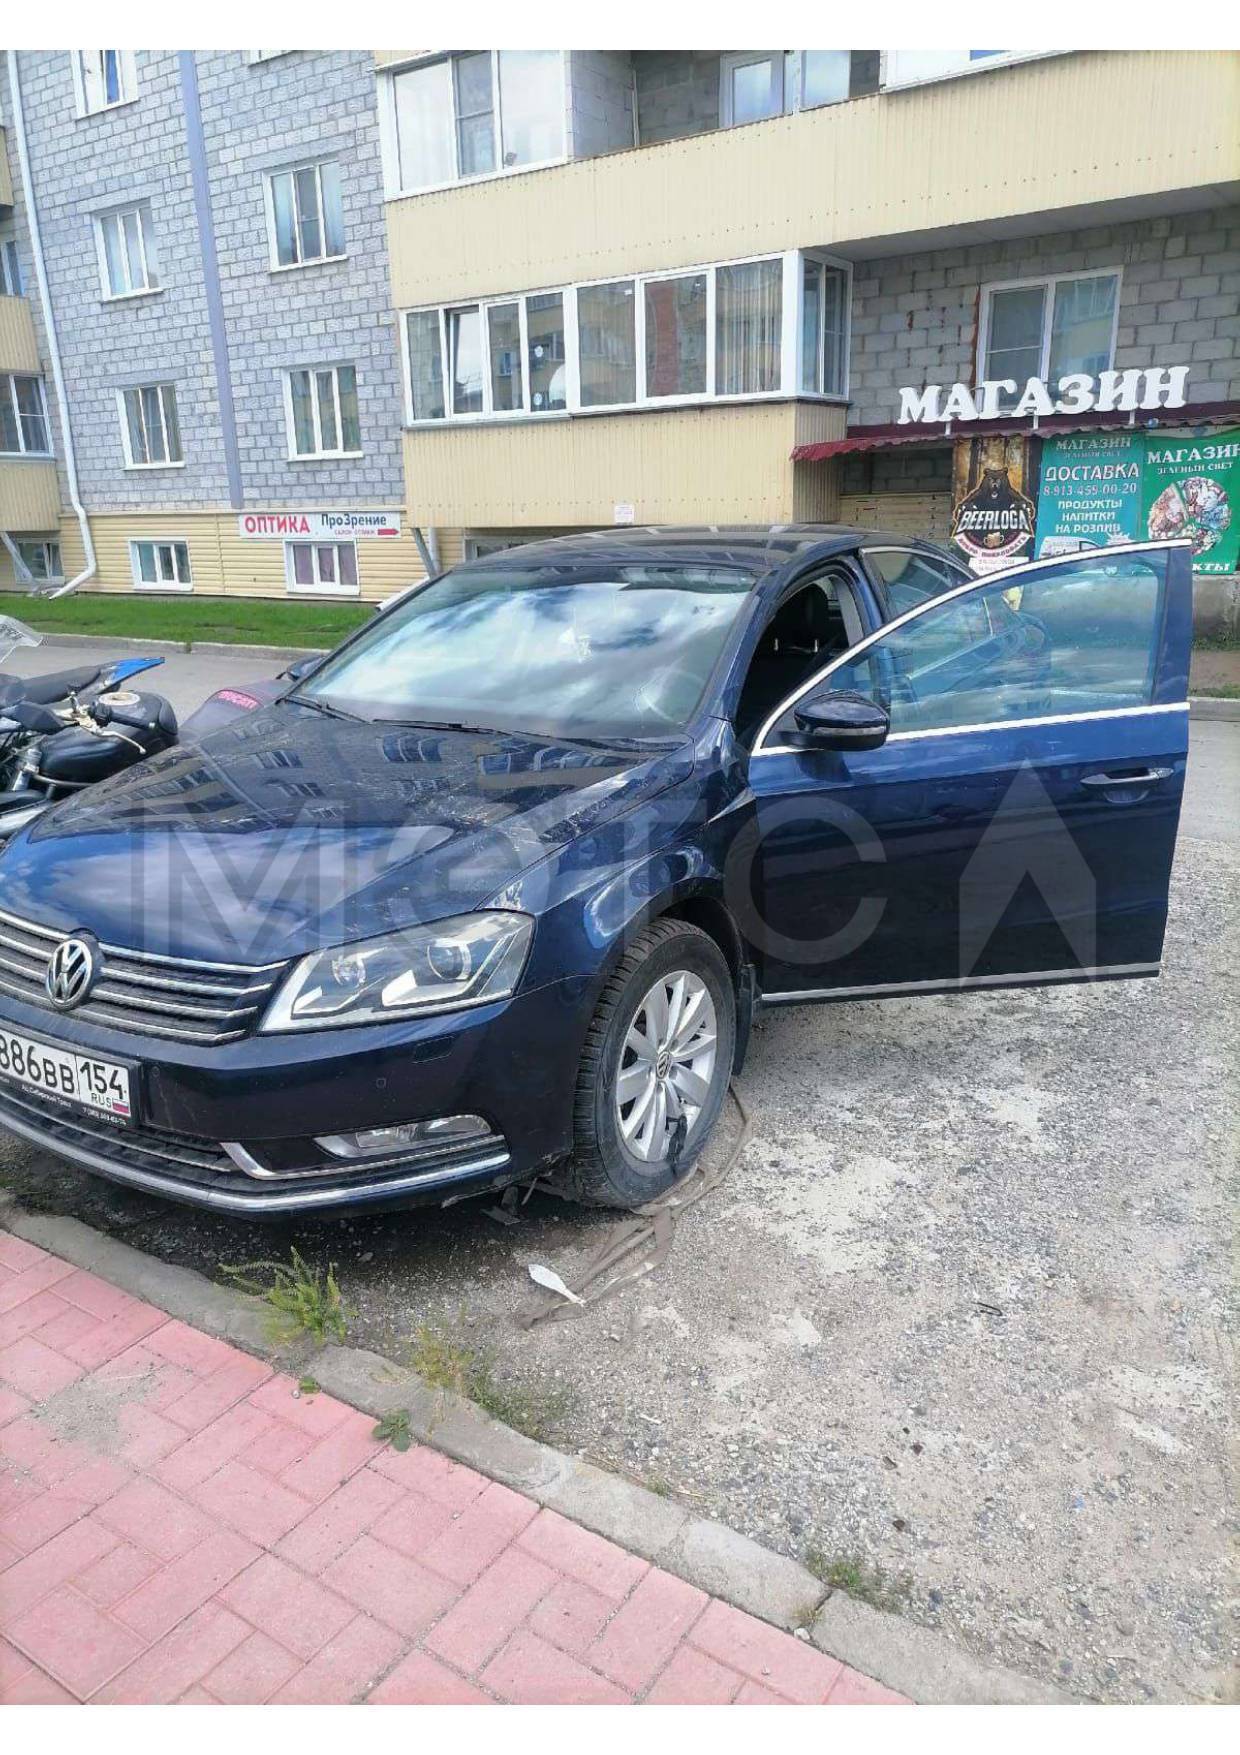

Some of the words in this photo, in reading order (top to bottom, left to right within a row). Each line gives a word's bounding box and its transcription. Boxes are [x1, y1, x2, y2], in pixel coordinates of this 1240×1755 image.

[897, 366, 1190, 425] МАГАЗИН
[1056, 437, 1131, 451] МАГАЗИН
[1045, 462, 1140, 482] ДОСТАВКА
[1057, 498, 1123, 510] ПРОДУКТЫ
[244, 514, 311, 534] ОПТИКА
[321, 513, 387, 529] ПроЗрение
[956, 510, 1031, 533] BEERLOGA
[1062, 511, 1115, 522] НАПИТКИ
[1055, 523, 1073, 534] НА
[80, 1061, 124, 1100] 154
[91, 1092, 112, 1109] RUS
